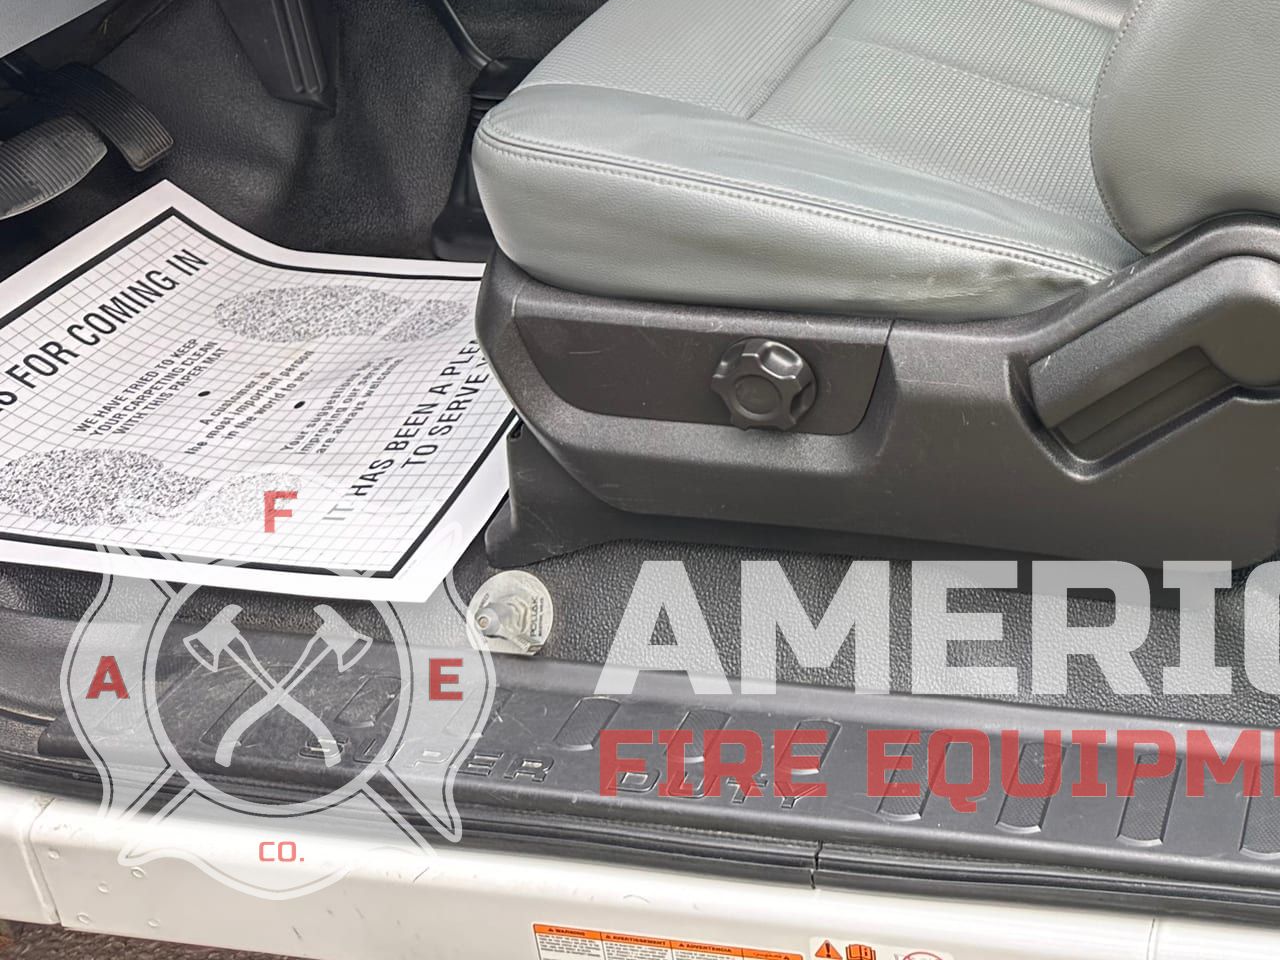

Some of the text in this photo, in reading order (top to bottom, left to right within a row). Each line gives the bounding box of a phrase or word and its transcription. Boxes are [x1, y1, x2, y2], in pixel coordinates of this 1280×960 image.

[5, 248, 209, 389] FOR COMING IN
[73, 338, 199, 433] WE HAVE TRIED TO KEEP
[89, 340, 219, 436] YOUR CARPETING CLEAN
[112, 346, 229, 435] WITH THIS PAPER MAT
[184, 350, 315, 455] the most important person
[199, 418, 214, 426] A
[210, 380, 258, 417] customer
[221, 429, 240, 440] in
[234, 414, 257, 430] the
[254, 392, 286, 415] world
[280, 382, 297, 393] to
[297, 407, 348, 455] improving
[342, 388, 361, 404] our
[315, 437, 335, 454] are
[332, 401, 367, 434] always
[401, 373, 489, 469] TO SERVE
[280, 431, 309, 452] Your
[321, 503, 354, 521] IT
[344, 458, 395, 497] HAS
[384, 401, 439, 451] BEEN
[428, 382, 453, 396] A
[298, 737, 819, 810] SUPER DUTY
